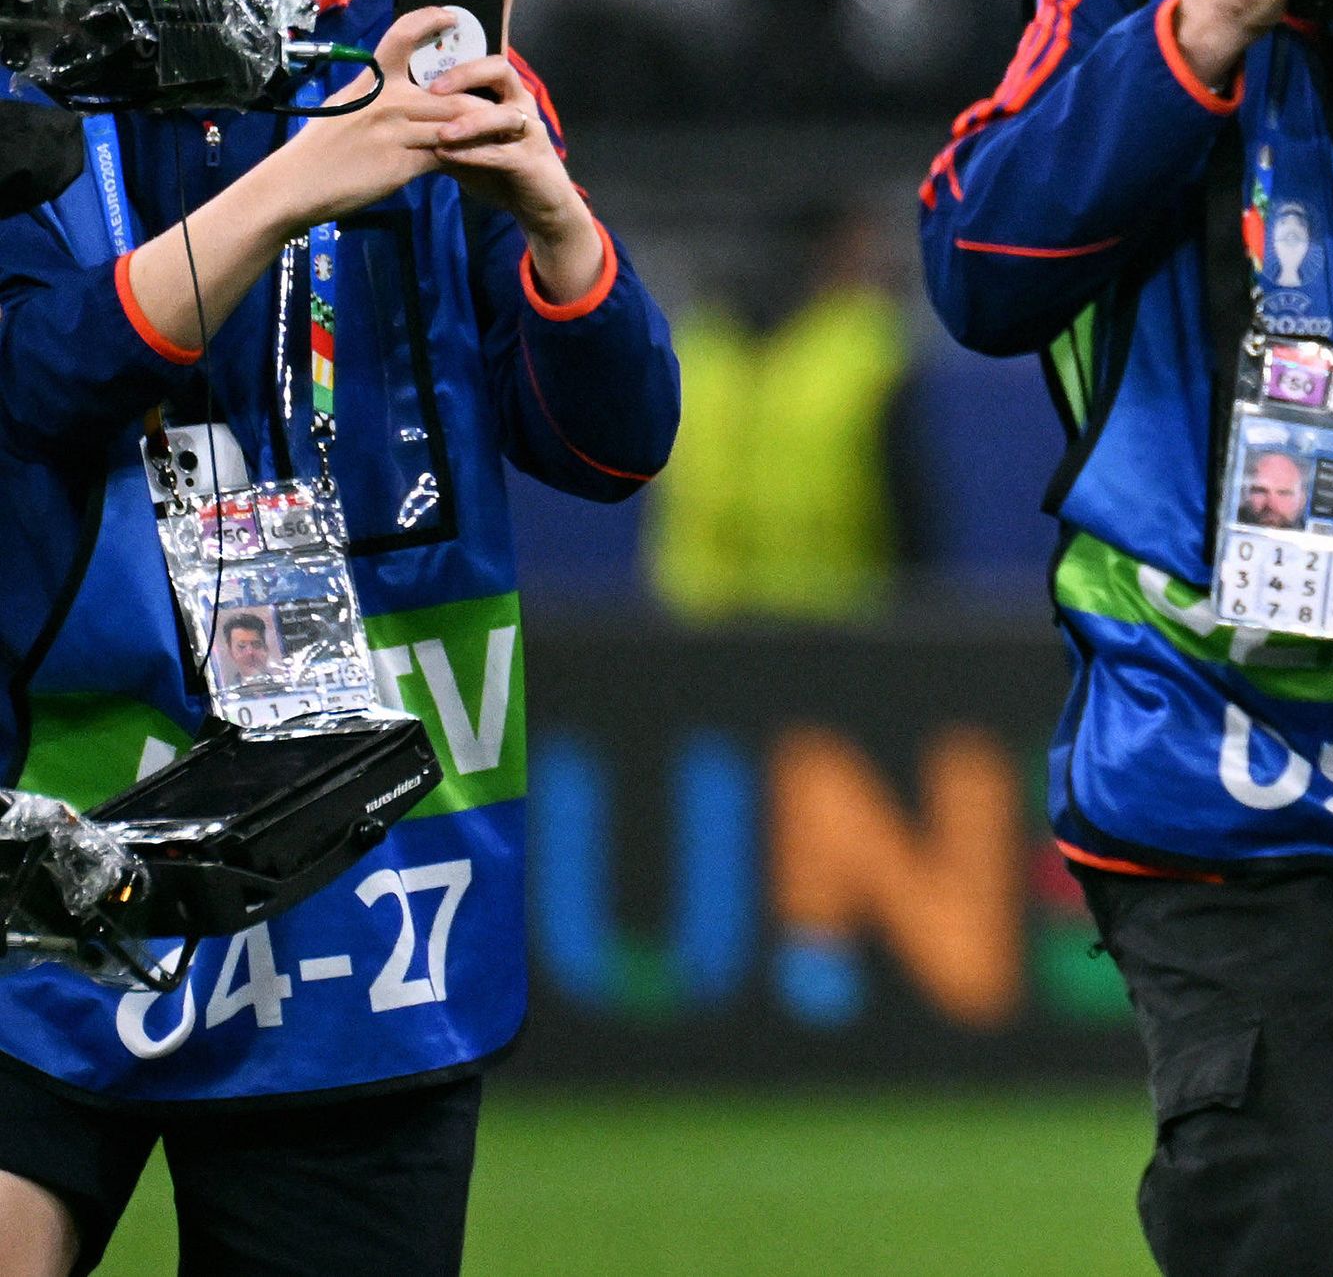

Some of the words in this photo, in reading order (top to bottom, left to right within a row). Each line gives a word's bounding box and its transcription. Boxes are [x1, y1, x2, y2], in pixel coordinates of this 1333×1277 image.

[1239, 541, 1254, 562] 0
[1274, 547, 1284, 567] 1
[1306, 551, 1319, 572] 2
[1236, 571, 1249, 590] 3
[1269, 577, 1284, 592] 4
[1303, 580, 1316, 598] 5
[1233, 599, 1247, 616] 6
[1268, 603, 1280, 619] 7
[1298, 605, 1313, 624] 8
